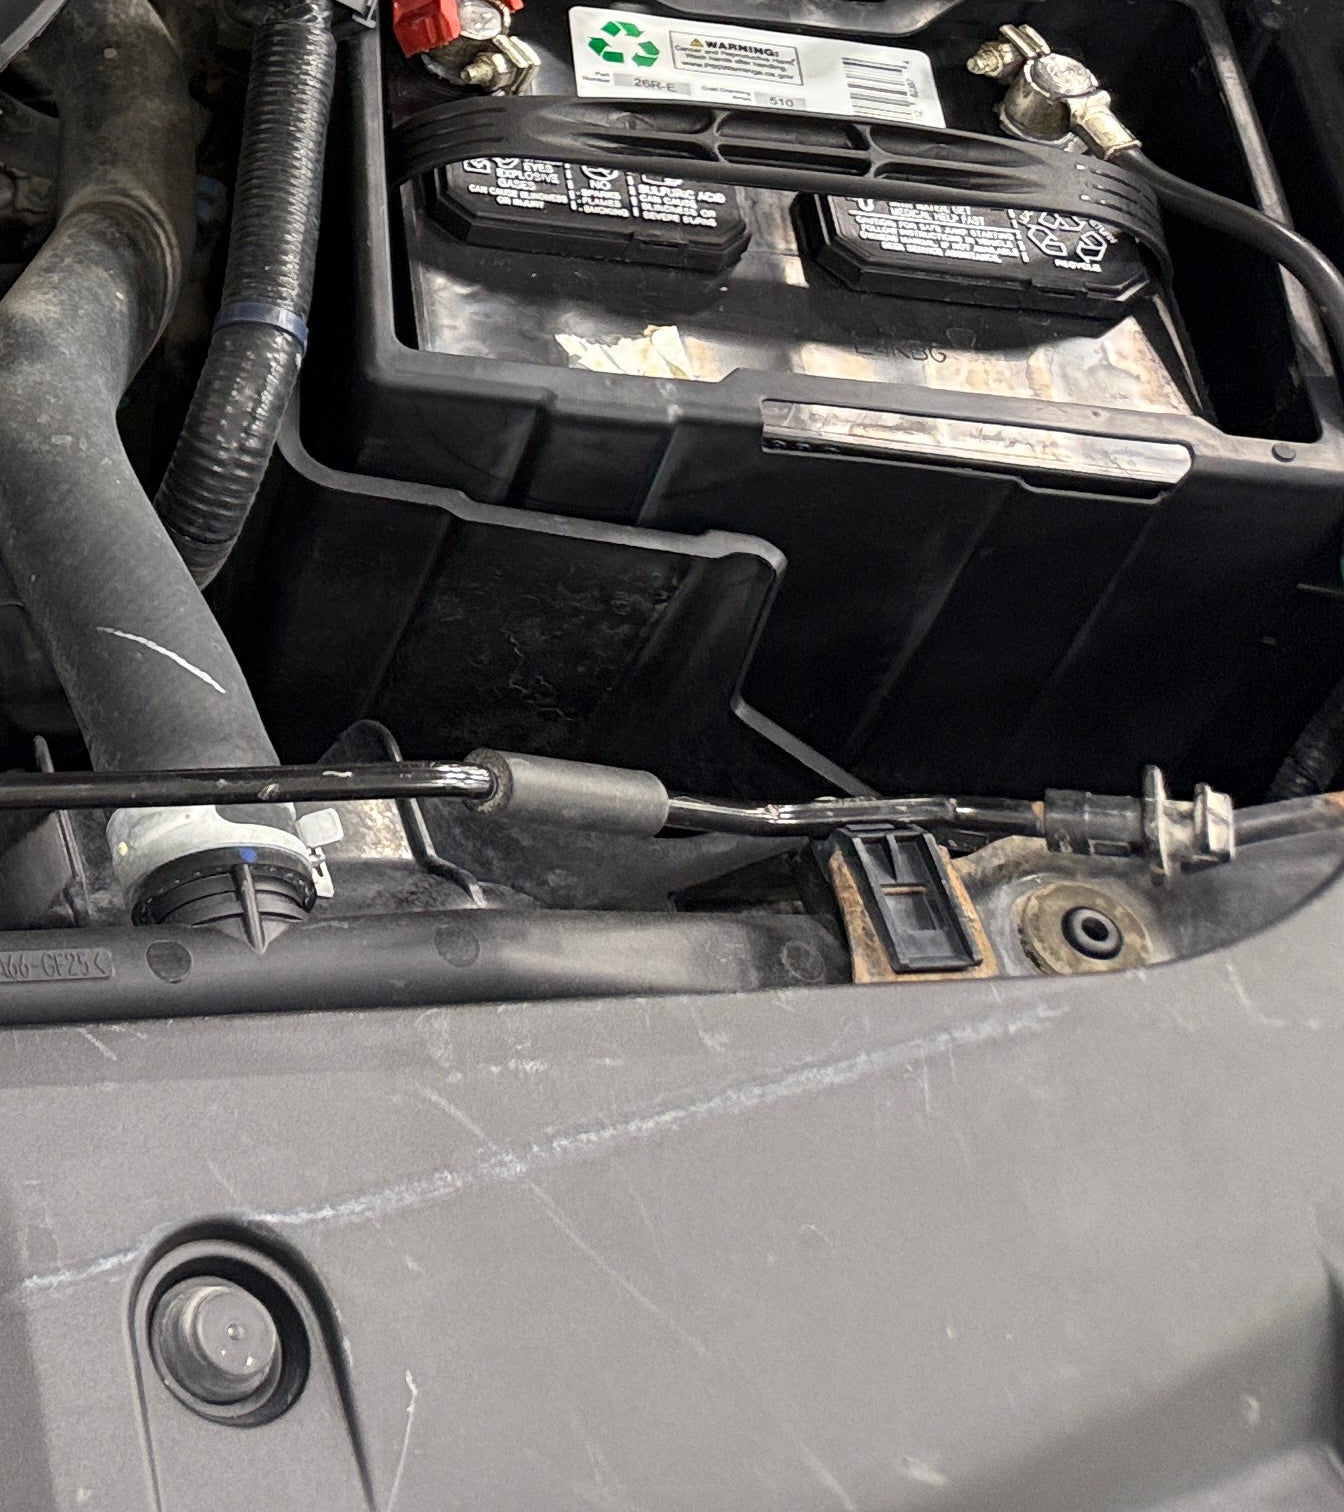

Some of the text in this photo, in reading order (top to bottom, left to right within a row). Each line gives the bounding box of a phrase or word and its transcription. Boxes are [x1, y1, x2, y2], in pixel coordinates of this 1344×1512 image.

[675, 45, 702, 53] Cancer
[705, 40, 780, 57] WARNING:
[769, 96, 795, 108] 510
[523, 163, 554, 173] EYES
[496, 168, 560, 185] EXPLOSIVE
[497, 178, 537, 191] GASES
[589, 179, 611, 190] NO
[468, 184, 488, 194] CAN
[489, 187, 518, 198] CAUSE
[638, 184, 726, 204] SULFURIC ACID
[639, 194, 661, 204] CAN
[890, 207, 985, 226] MEDICAL HELP FAST
[898, 221, 918, 230] FOR
[919, 223, 942, 233] SAFE
